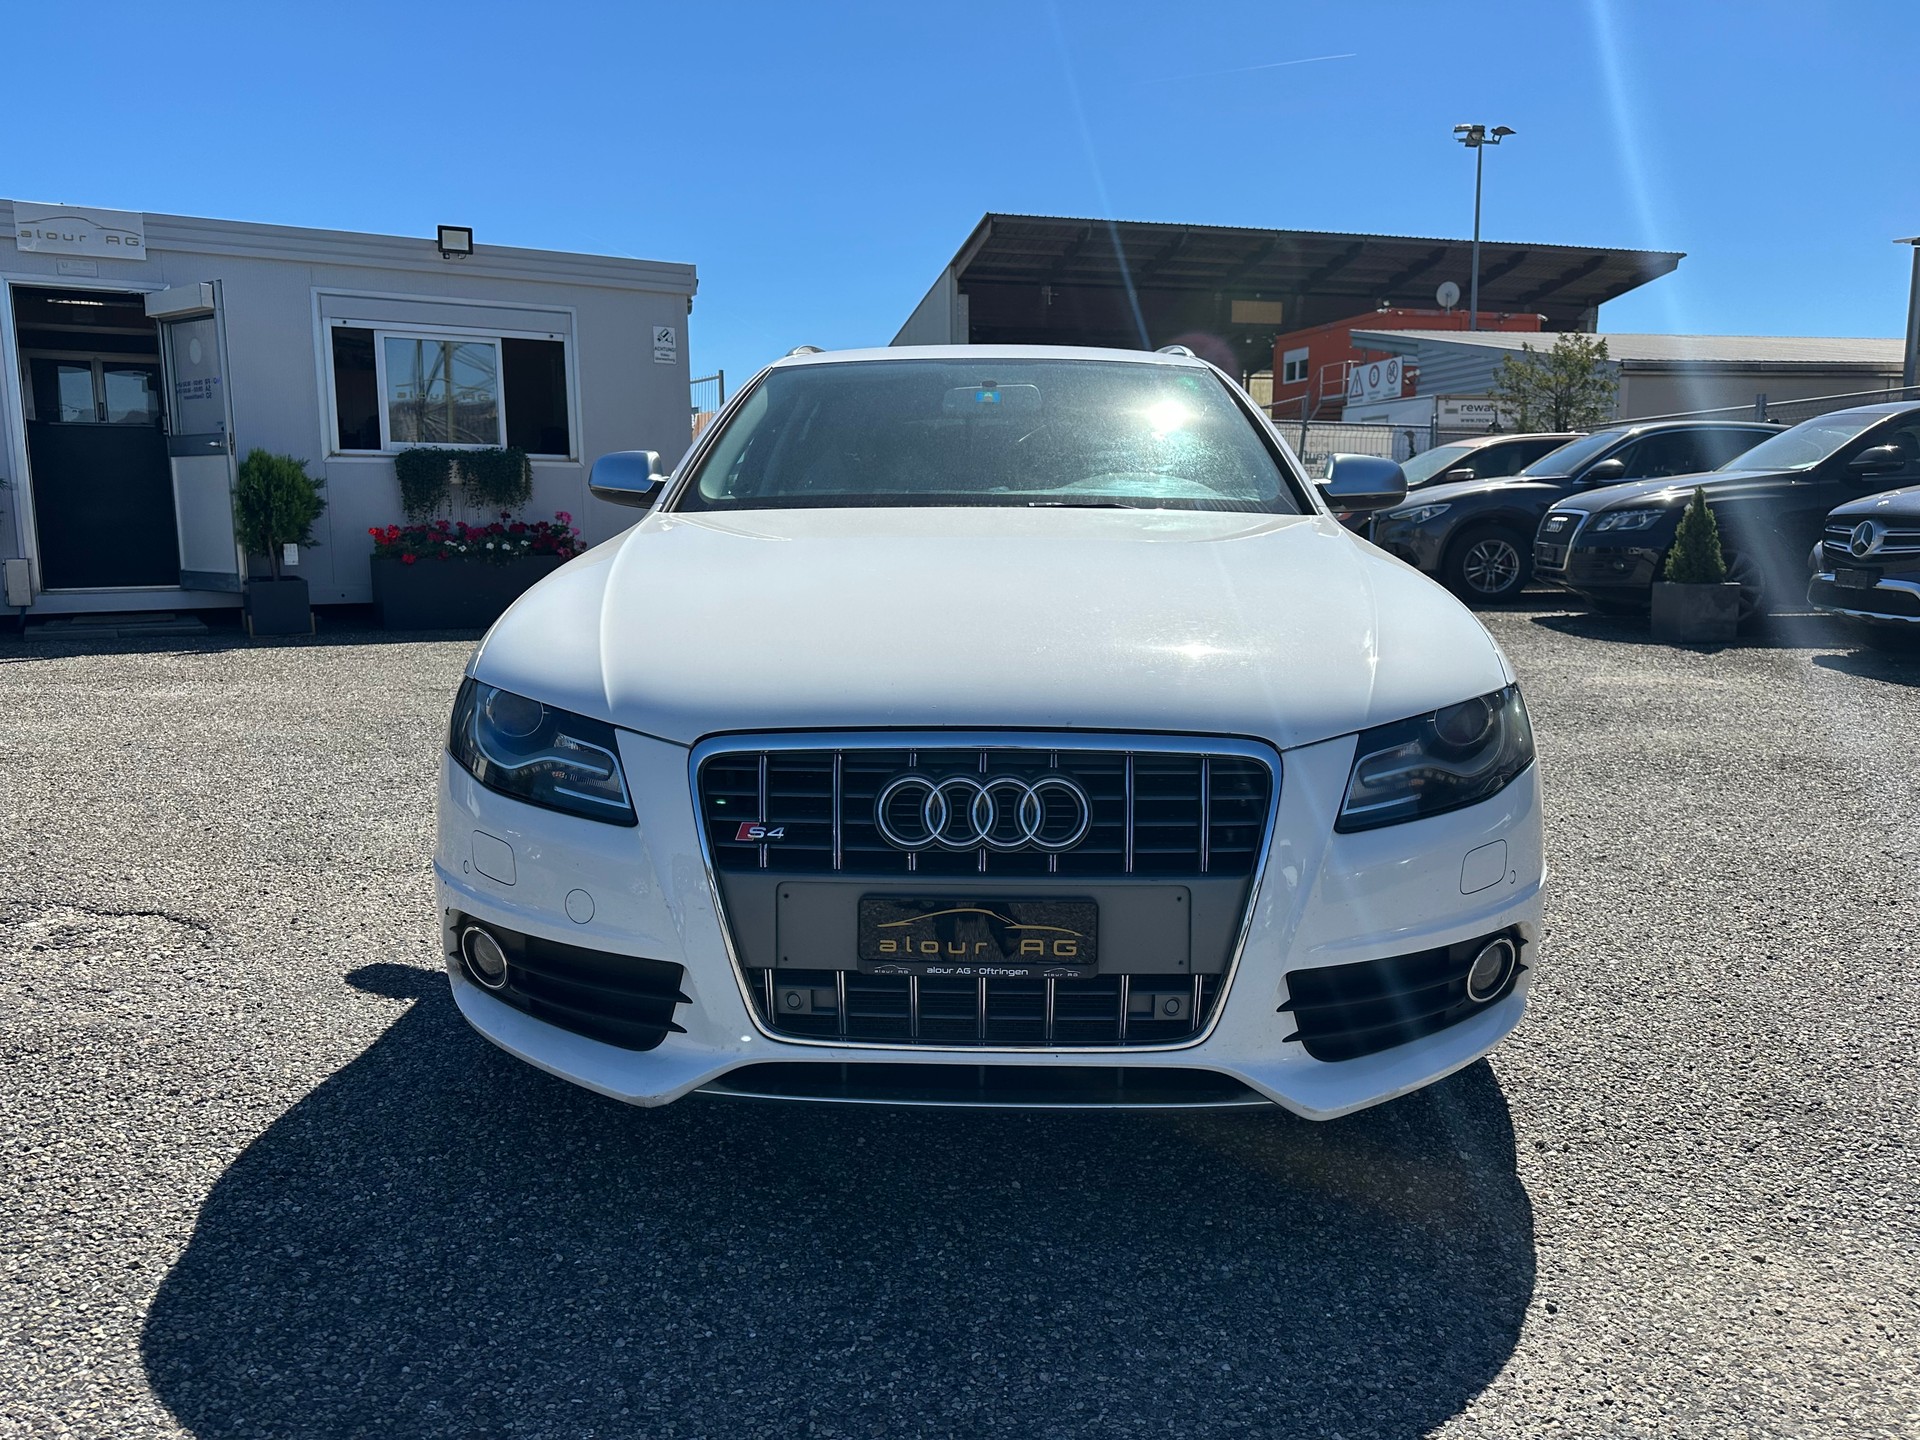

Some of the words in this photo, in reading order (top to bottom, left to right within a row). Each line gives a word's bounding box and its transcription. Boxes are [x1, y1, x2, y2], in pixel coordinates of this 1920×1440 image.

[20, 229, 87, 242] alour
[105, 235, 140, 247] AG
[747, 826, 785, 839] S4
[879, 936, 988, 954] alour
[1020, 939, 1078, 956] AG
[926, 966, 955, 974] alour
[978, 967, 1029, 977] Oftringen
